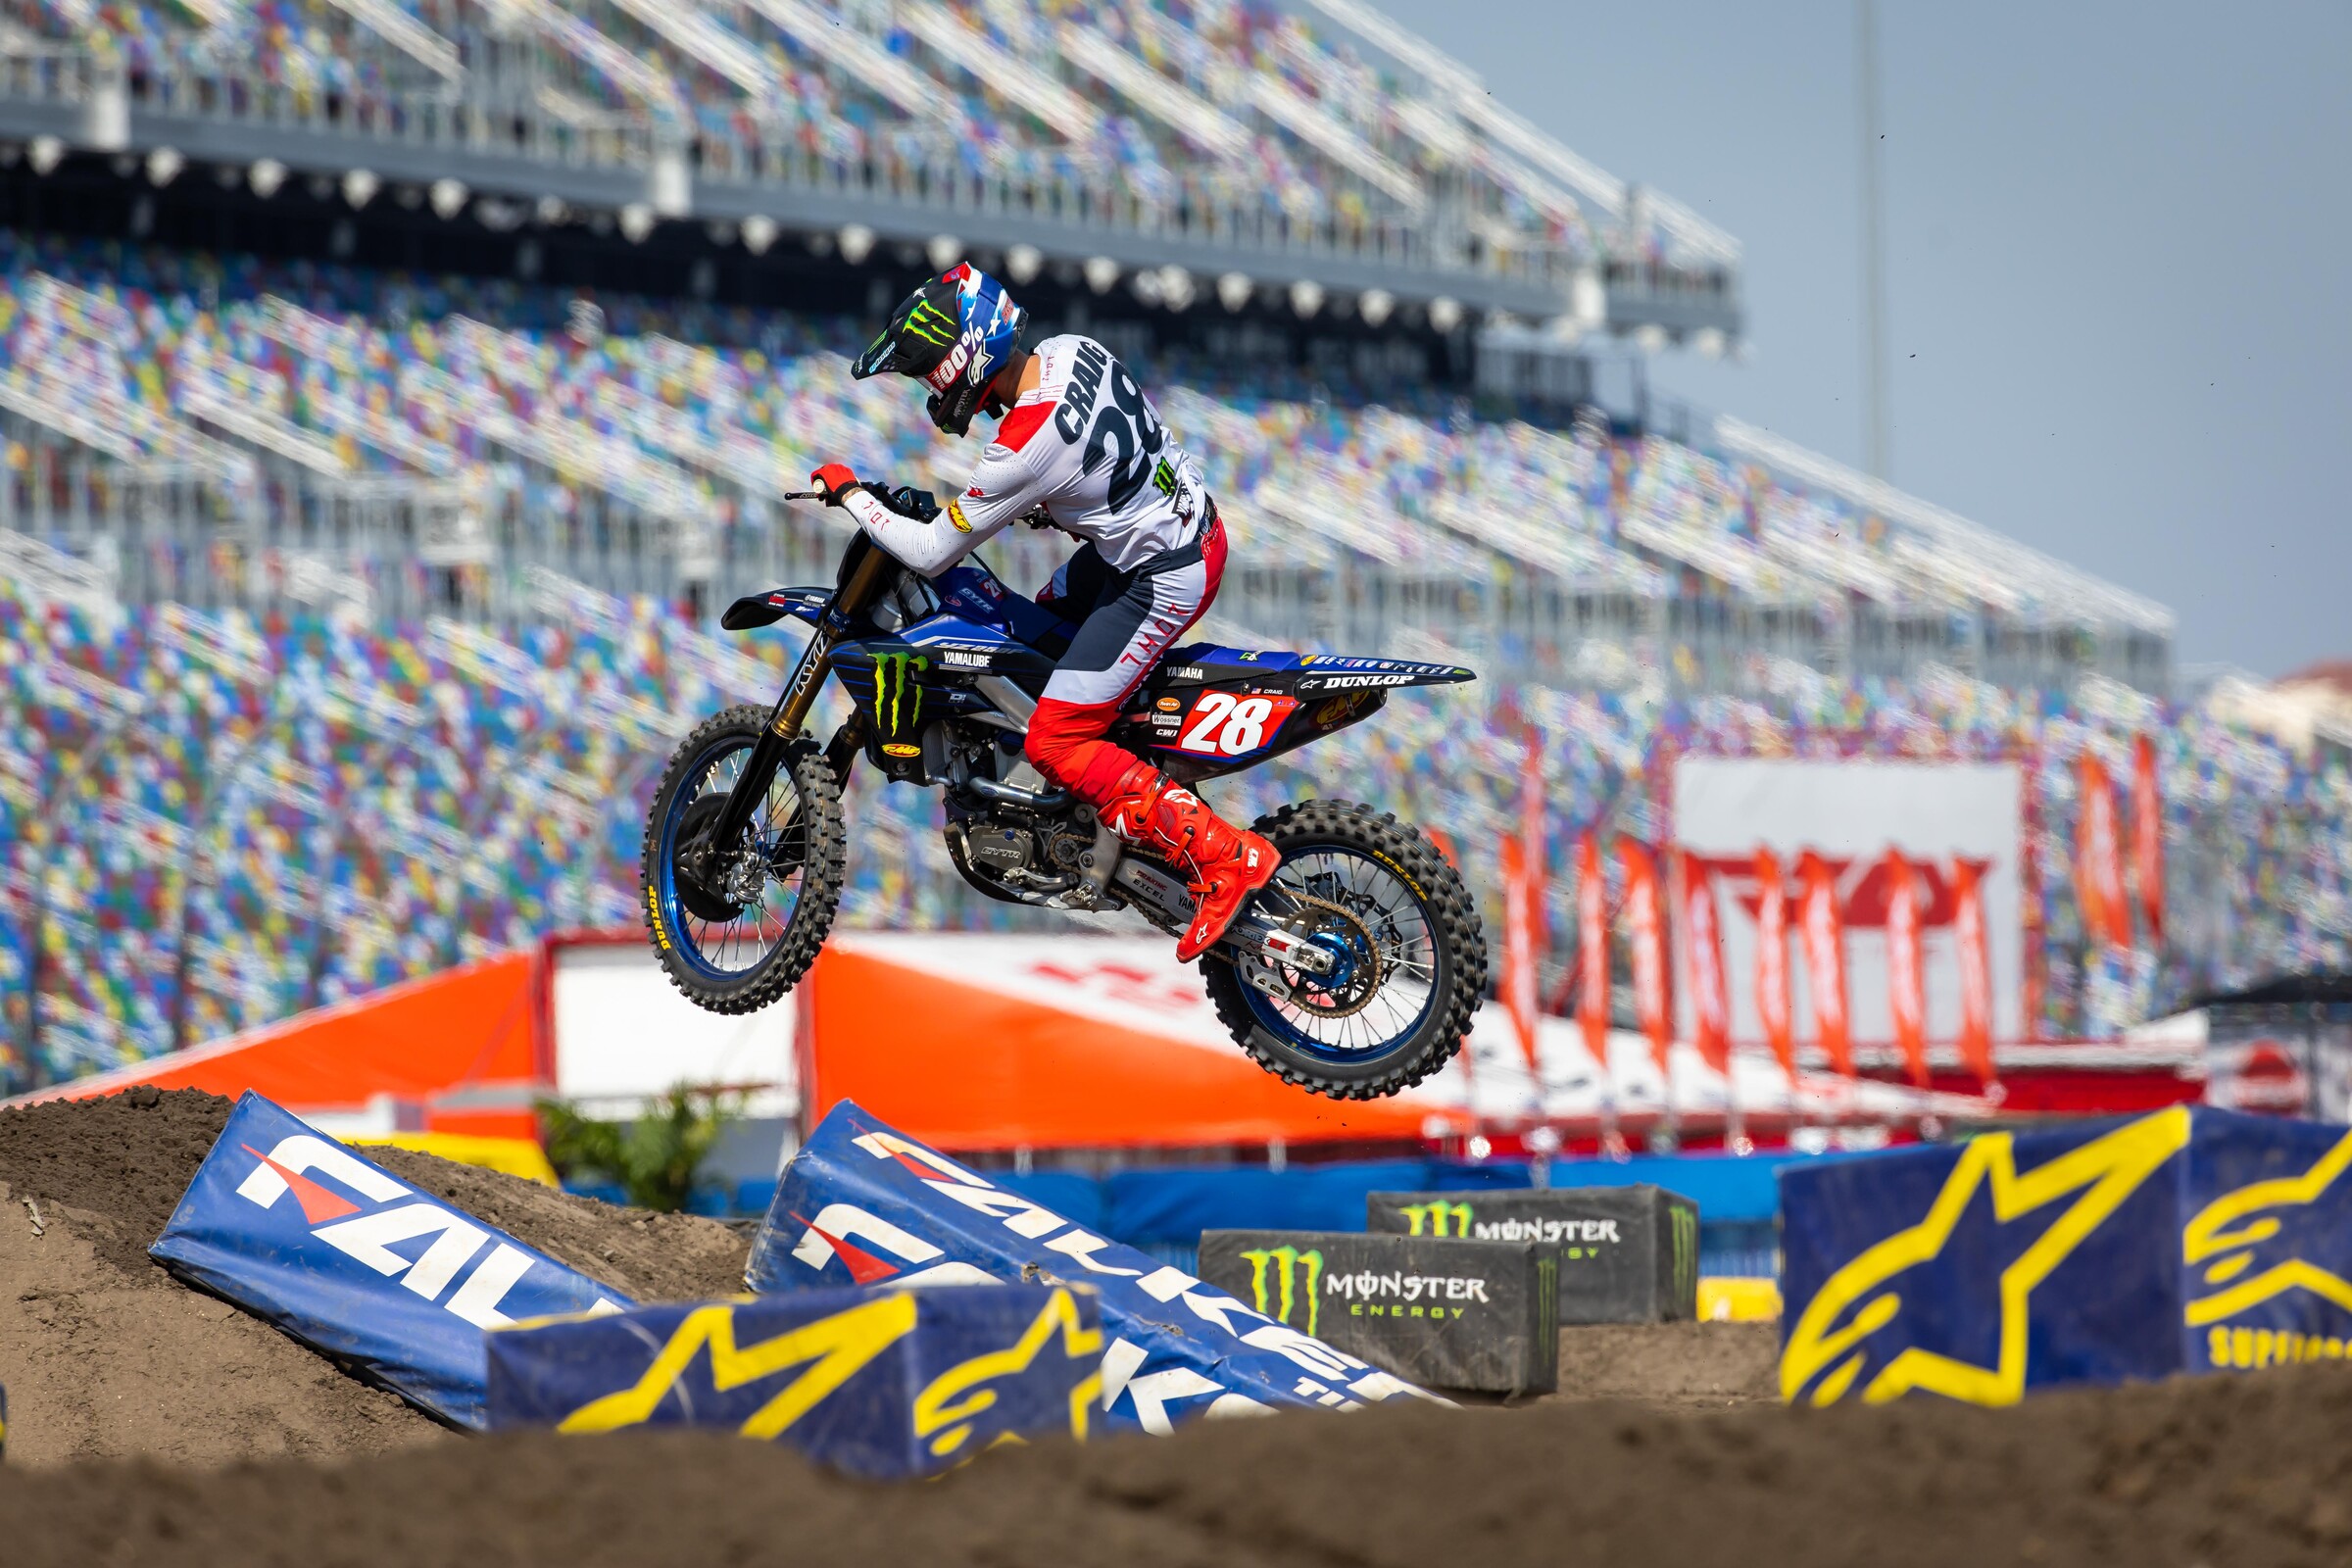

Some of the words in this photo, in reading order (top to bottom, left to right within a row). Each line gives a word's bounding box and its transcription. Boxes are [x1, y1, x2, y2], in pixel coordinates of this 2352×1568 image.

[931, 321, 984, 389] 100%
[1054, 341, 1107, 445] CRAIG
[1082, 360, 1163, 515] 28
[944, 651, 990, 667] YAMALUBE
[1166, 666, 1203, 679] YAMAHA
[1324, 675, 1415, 689] DUNLOP
[1180, 693, 1273, 756] 28
[883, 745, 920, 755] FMF
[981, 847, 1020, 858] GYTR
[1133, 878, 1164, 902] EXCEL
[1137, 870, 1167, 891] BRAKING
[648, 885, 671, 950] DUNLOP
[1474, 1216, 1621, 1244] MONSTER
[1326, 1270, 1490, 1303] MONSTER
[1350, 1304, 1465, 1319] ENERGY
